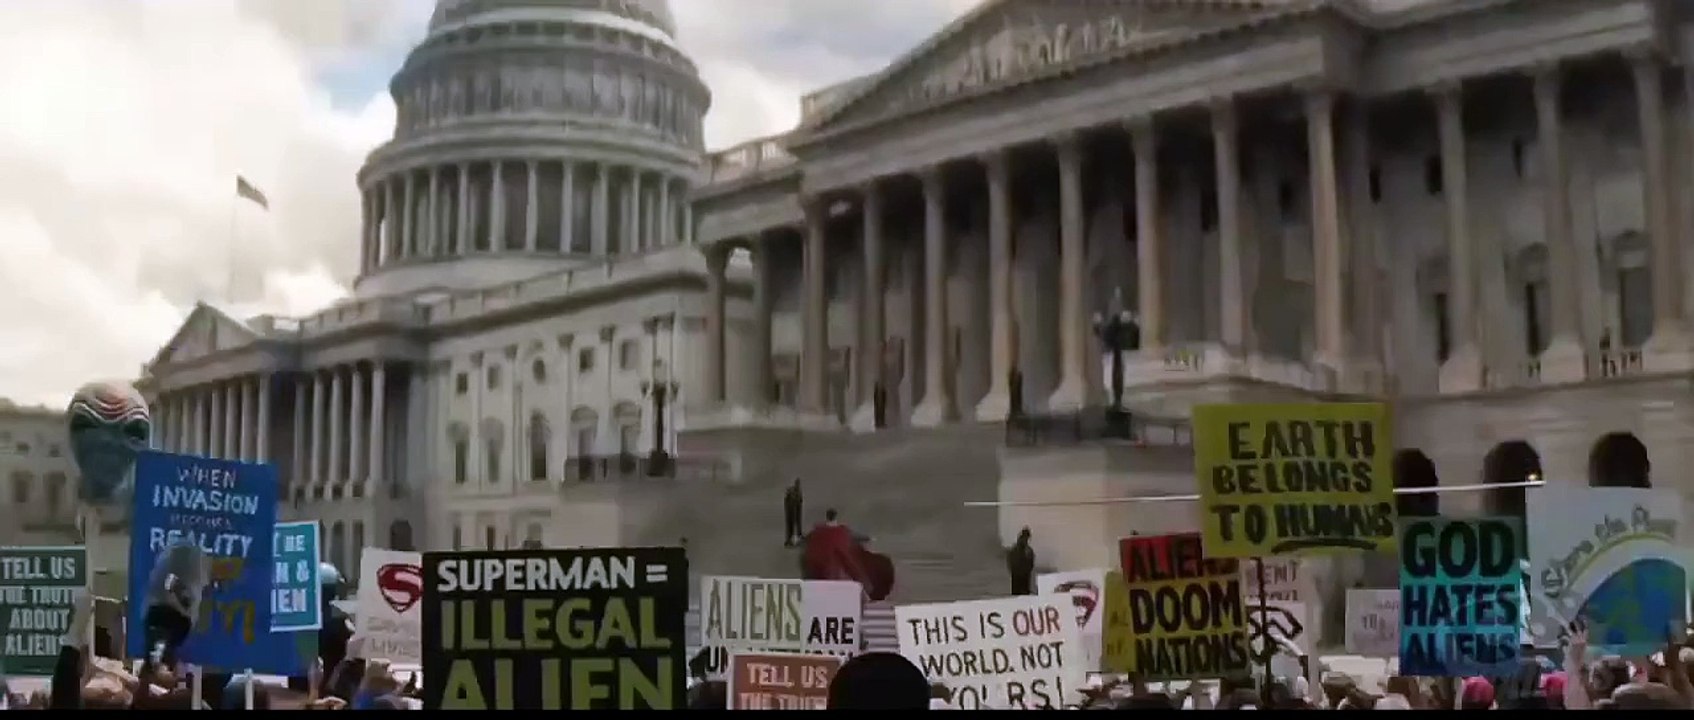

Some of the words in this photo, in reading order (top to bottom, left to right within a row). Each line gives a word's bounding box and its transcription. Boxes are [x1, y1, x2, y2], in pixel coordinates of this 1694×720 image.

[1228, 420, 1376, 460] EARTH
[176, 464, 237, 489] WHEN
[1212, 461, 1373, 494] BELONGS
[152, 484, 259, 515] INVASION
[1210, 504, 1267, 545] TO
[1273, 501, 1395, 538] HUMANS
[149, 526, 254, 559] REALITY
[1403, 520, 1516, 579] GOD
[1, 557, 47, 580] TELL
[50, 556, 76, 580] US
[437, 556, 636, 593] SUPERMAN
[9, 607, 70, 632] ABOUT
[705, 578, 802, 642] ALIENS
[1129, 579, 1243, 634] DOOM
[1403, 583, 1518, 627] HATES
[440, 597, 673, 651] ILLEGAL
[807, 617, 855, 645] ARE
[907, 615, 968, 646] THIS
[979, 611, 1005, 639] IS
[1012, 605, 1062, 637] OUR
[919, 648, 1015, 678] WORLD.
[1020, 641, 1064, 672] NOT
[1136, 630, 1249, 677] NATIONS
[1404, 632, 1516, 667] ALIENS
[747, 662, 795, 688] TELL
[801, 665, 828, 689] US
